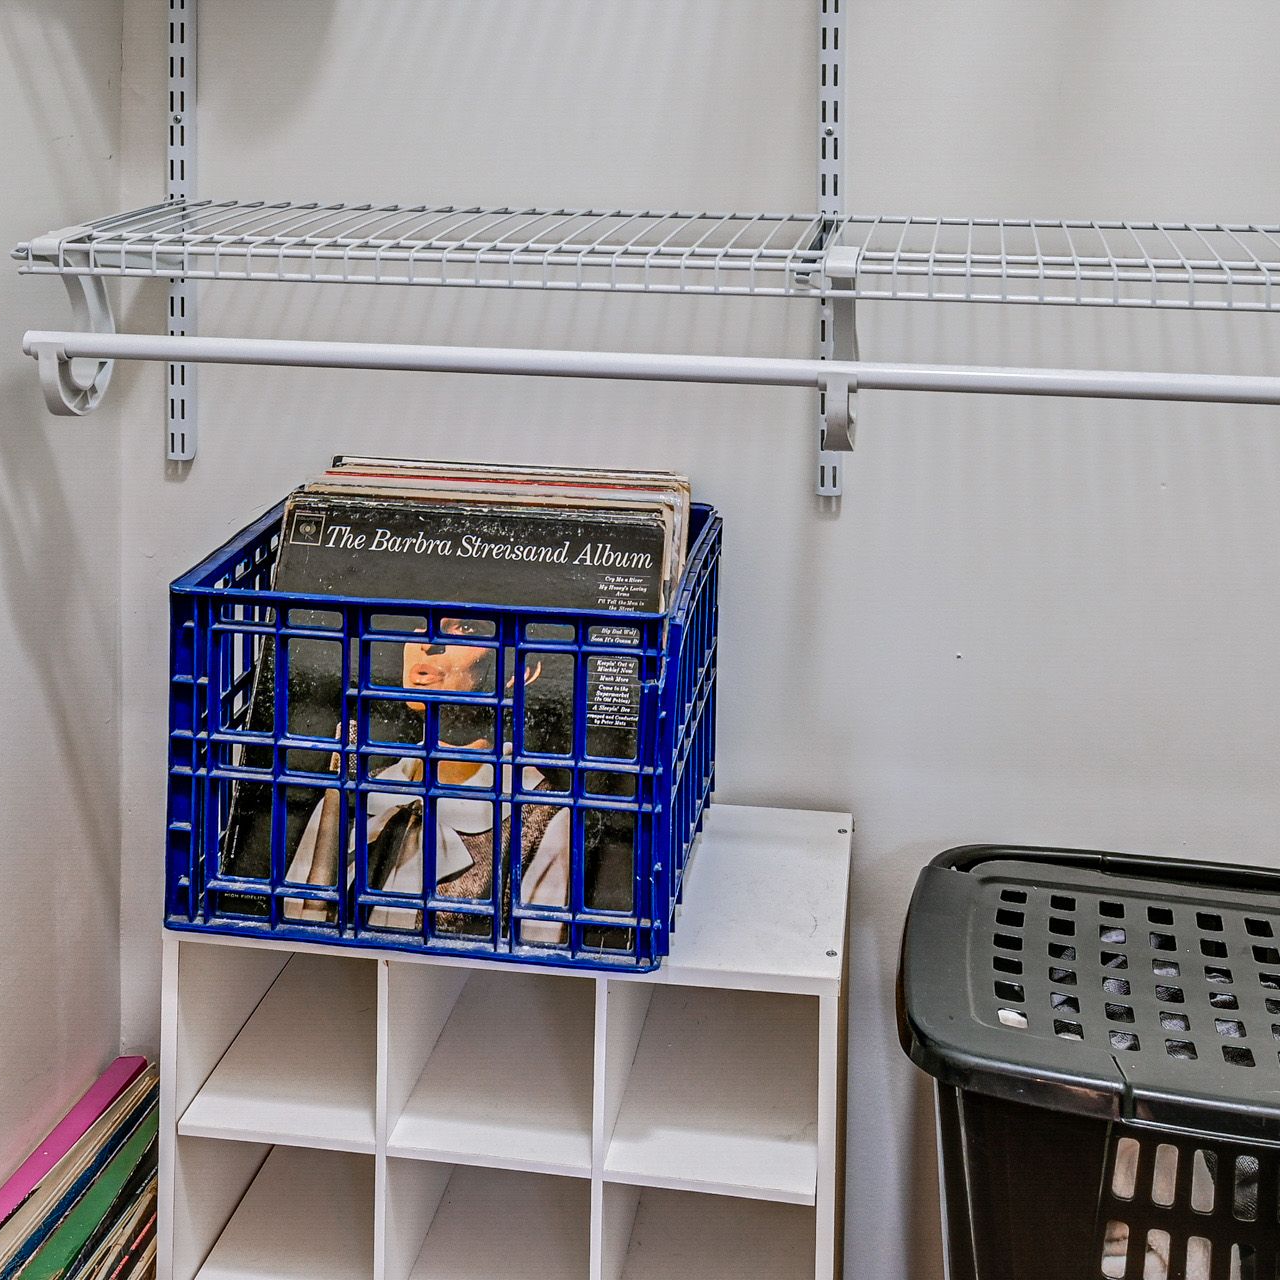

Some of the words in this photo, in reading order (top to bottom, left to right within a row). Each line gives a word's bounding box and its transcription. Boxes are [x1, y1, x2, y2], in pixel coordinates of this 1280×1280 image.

[325, 525, 367, 550] The
[368, 528, 453, 556] Barbra
[456, 534, 570, 564] Streisand
[572, 542, 653, 569] Album
[596, 690, 630, 698] Supermarket
